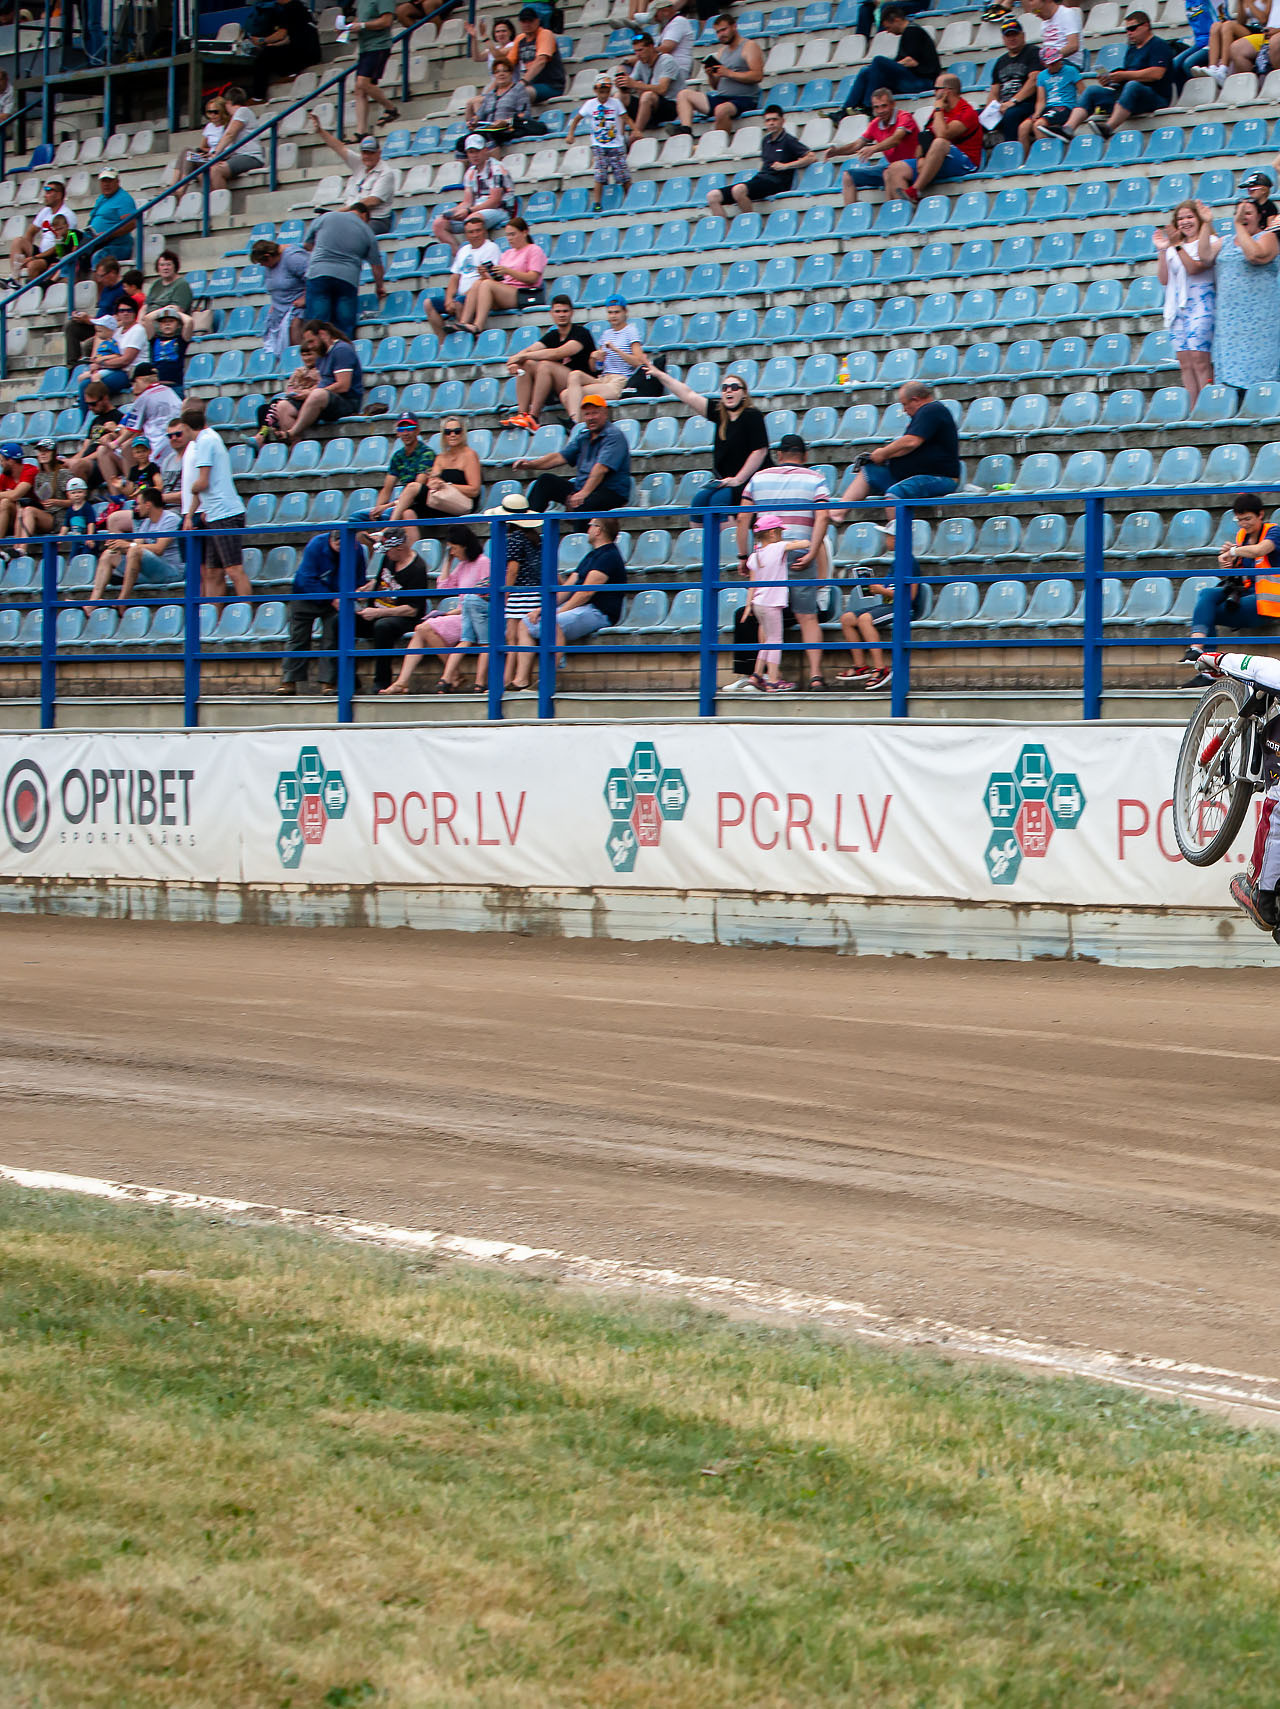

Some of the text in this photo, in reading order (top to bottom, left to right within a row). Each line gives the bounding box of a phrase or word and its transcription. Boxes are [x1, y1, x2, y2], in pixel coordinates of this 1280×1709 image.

[61, 768, 195, 826] OPTIBET
[373, 791, 527, 846] PCR.LV
[716, 791, 893, 853] PCR.LV
[1022, 836, 1047, 851] PCR
